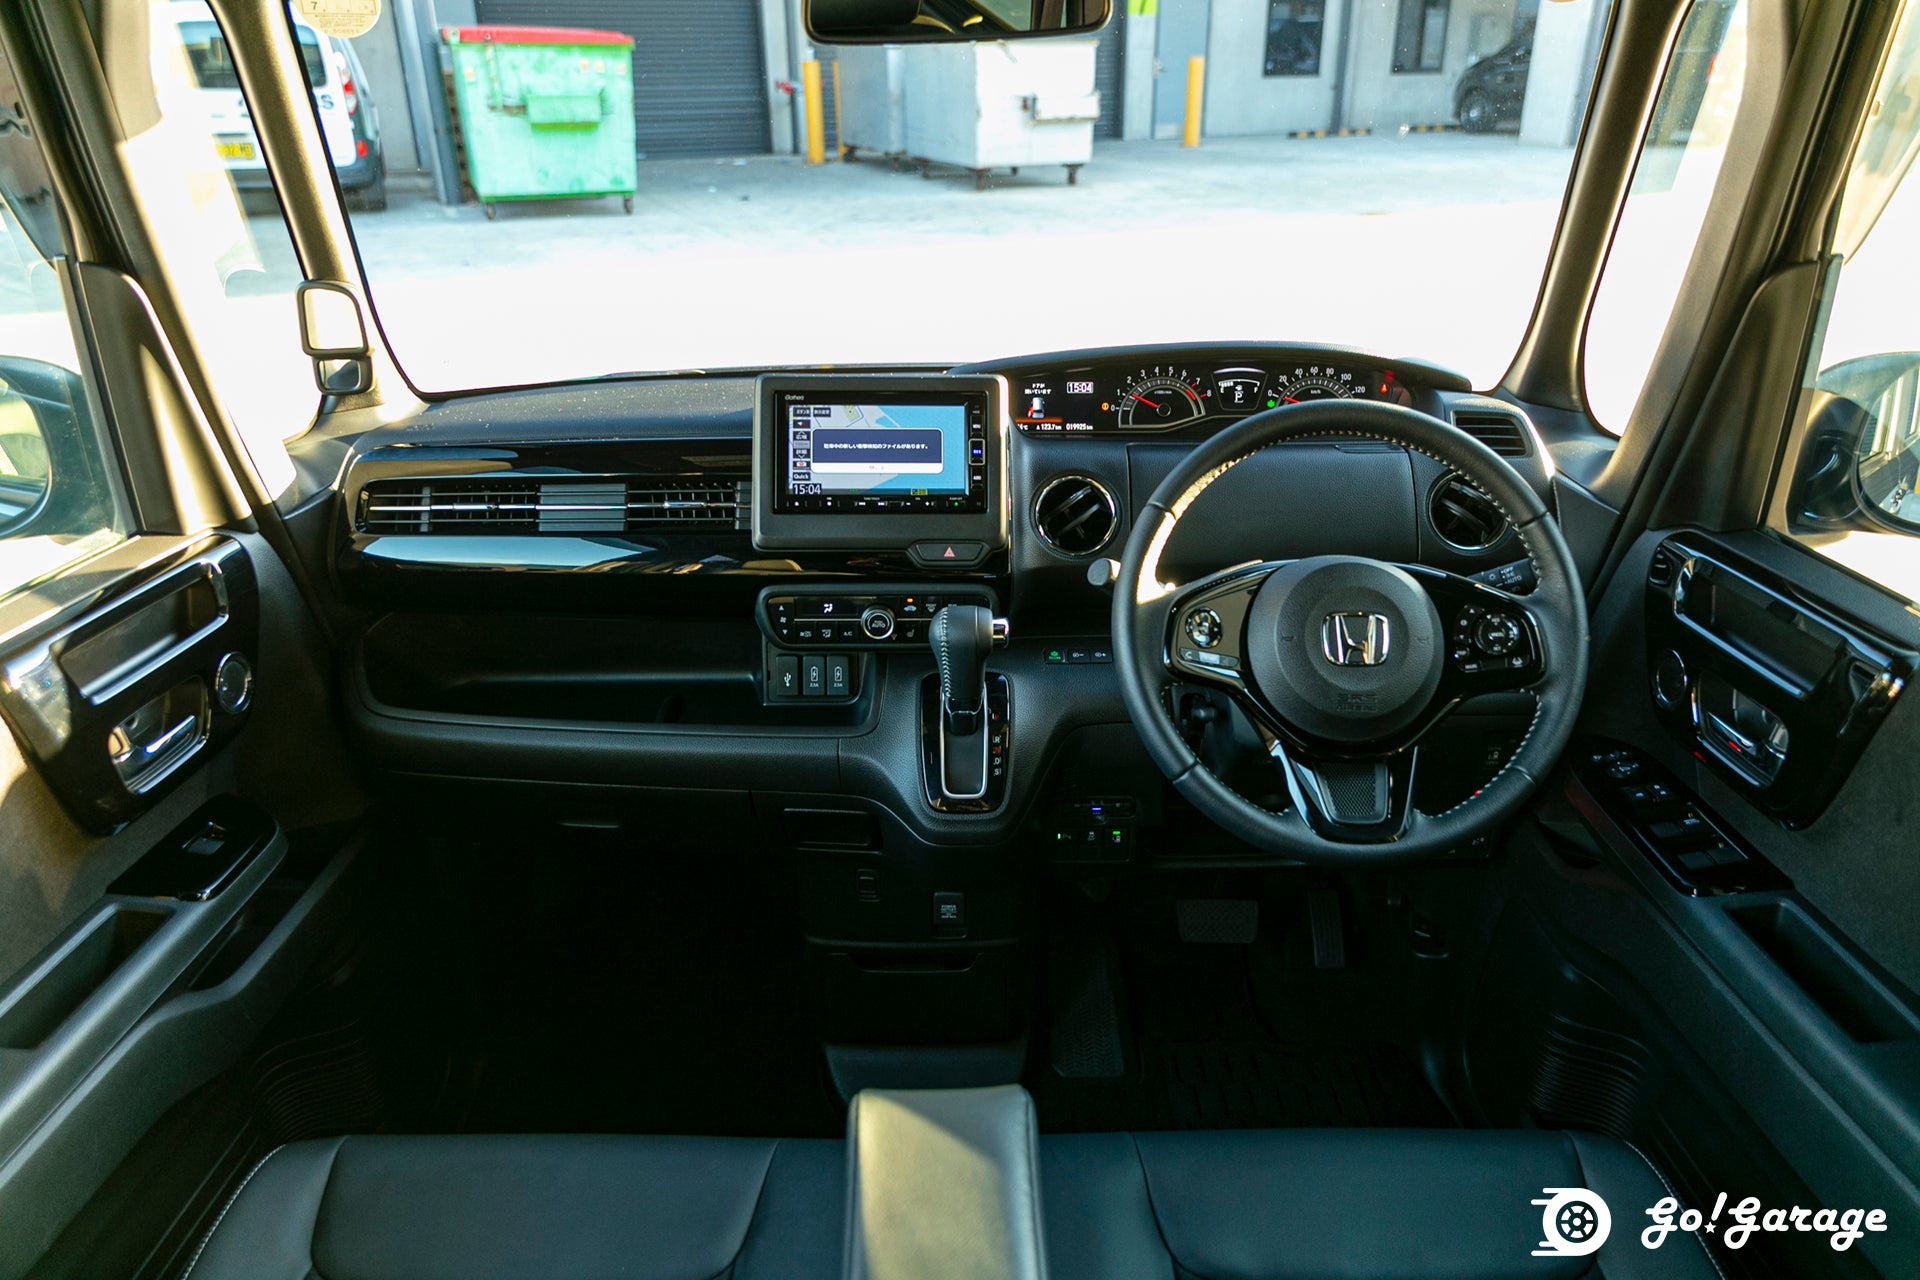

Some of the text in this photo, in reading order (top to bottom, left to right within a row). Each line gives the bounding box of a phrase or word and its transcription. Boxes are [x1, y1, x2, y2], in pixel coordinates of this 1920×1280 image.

[1140, 369, 1146, 377] 3
[1154, 366, 1160, 374] 4
[1168, 366, 1174, 374] 5
[1182, 369, 1187, 377] 6
[1295, 368, 1303, 376] 40
[1310, 366, 1319, 374] 60
[1326, 367, 1335, 375] 80
[1126, 376, 1132, 384] 2
[1195, 377, 1201, 385] 7
[1278, 375, 1288, 383] 20
[1340, 373, 1352, 381] 100
[1068, 383, 1092, 393] 15:04
[1354, 386, 1366, 394] 120
[793, 484, 821, 495] 15:04
